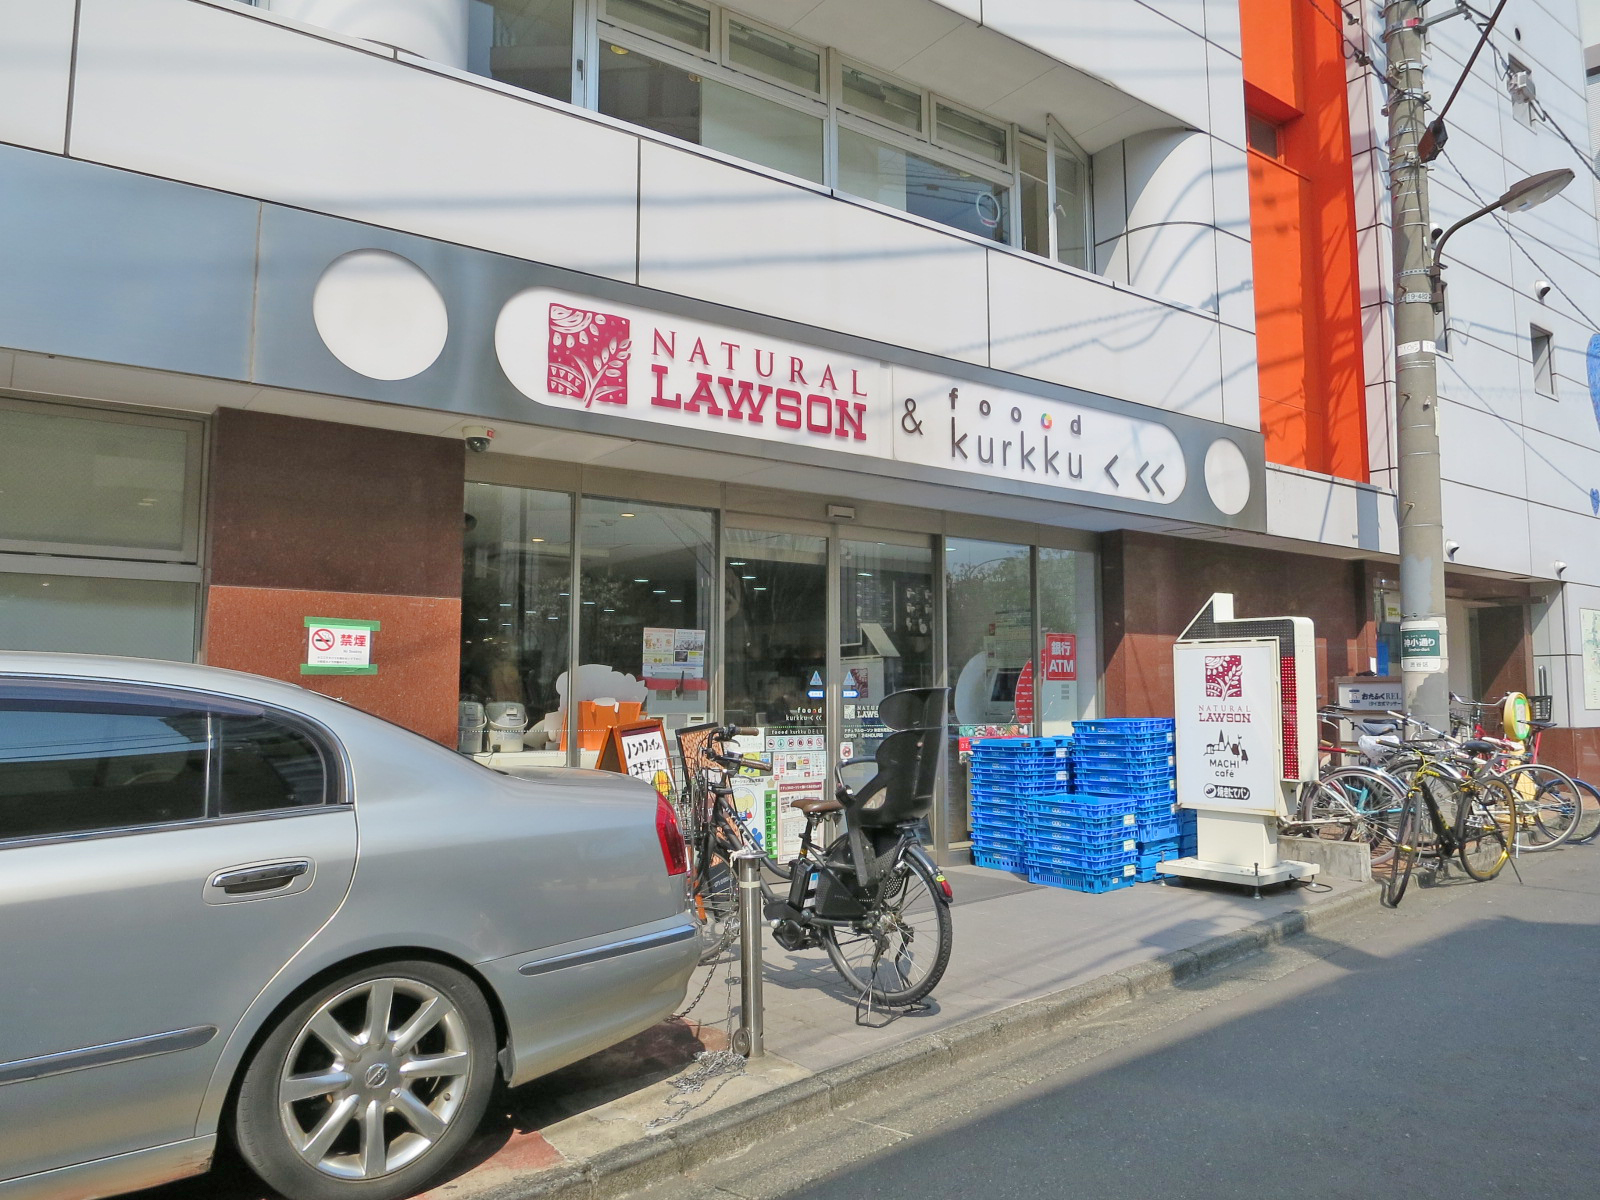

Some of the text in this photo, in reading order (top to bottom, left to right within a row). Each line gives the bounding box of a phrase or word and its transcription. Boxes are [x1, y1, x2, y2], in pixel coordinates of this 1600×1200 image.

[651, 328, 867, 397] NATURAL
[651, 364, 867, 440] LAWSON
[901, 398, 923, 435] &
[951, 417, 1083, 479] kurkku
[340, 633, 367, 647] 禁煙
[1403, 637, 1435, 647] 神小通り
[1051, 641, 1071, 656] 銀行
[1048, 659, 1074, 673] ATM
[857, 710, 879, 718] LAWS
[1198, 704, 1251, 713] NATURAL
[1198, 712, 1252, 723] LAWSON
[1209, 759, 1240, 768] MACHI
[1215, 769, 1234, 778] café
